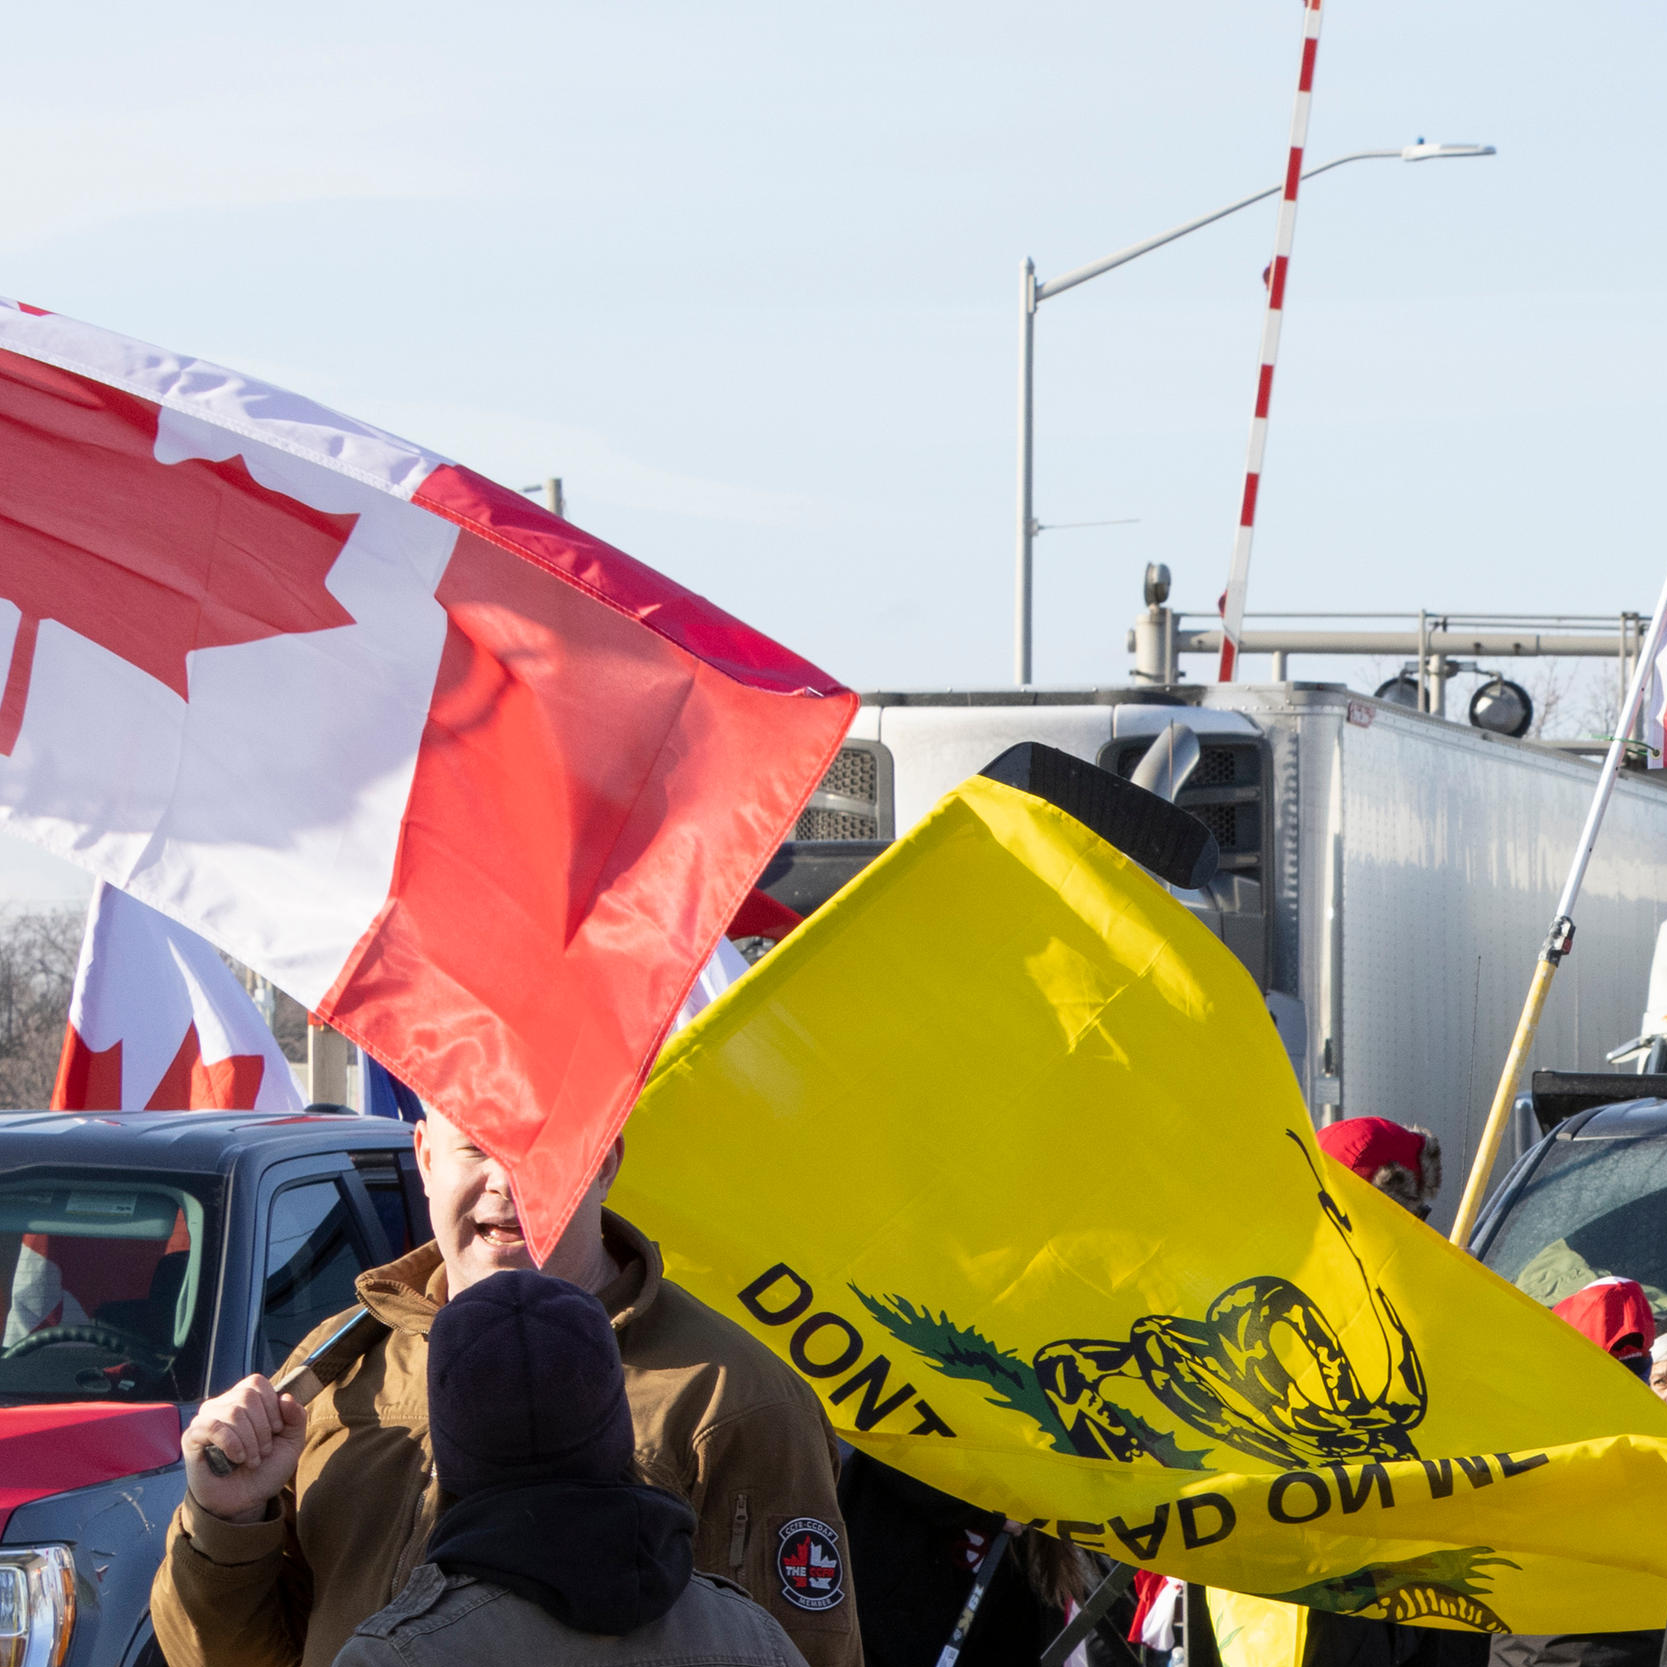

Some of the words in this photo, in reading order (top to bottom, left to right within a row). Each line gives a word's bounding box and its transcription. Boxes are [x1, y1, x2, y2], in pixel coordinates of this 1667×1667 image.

[786, 1566, 807, 1577] THE
[809, 1567, 835, 1578] CCFR
[798, 1598, 833, 1608] MEMBER
